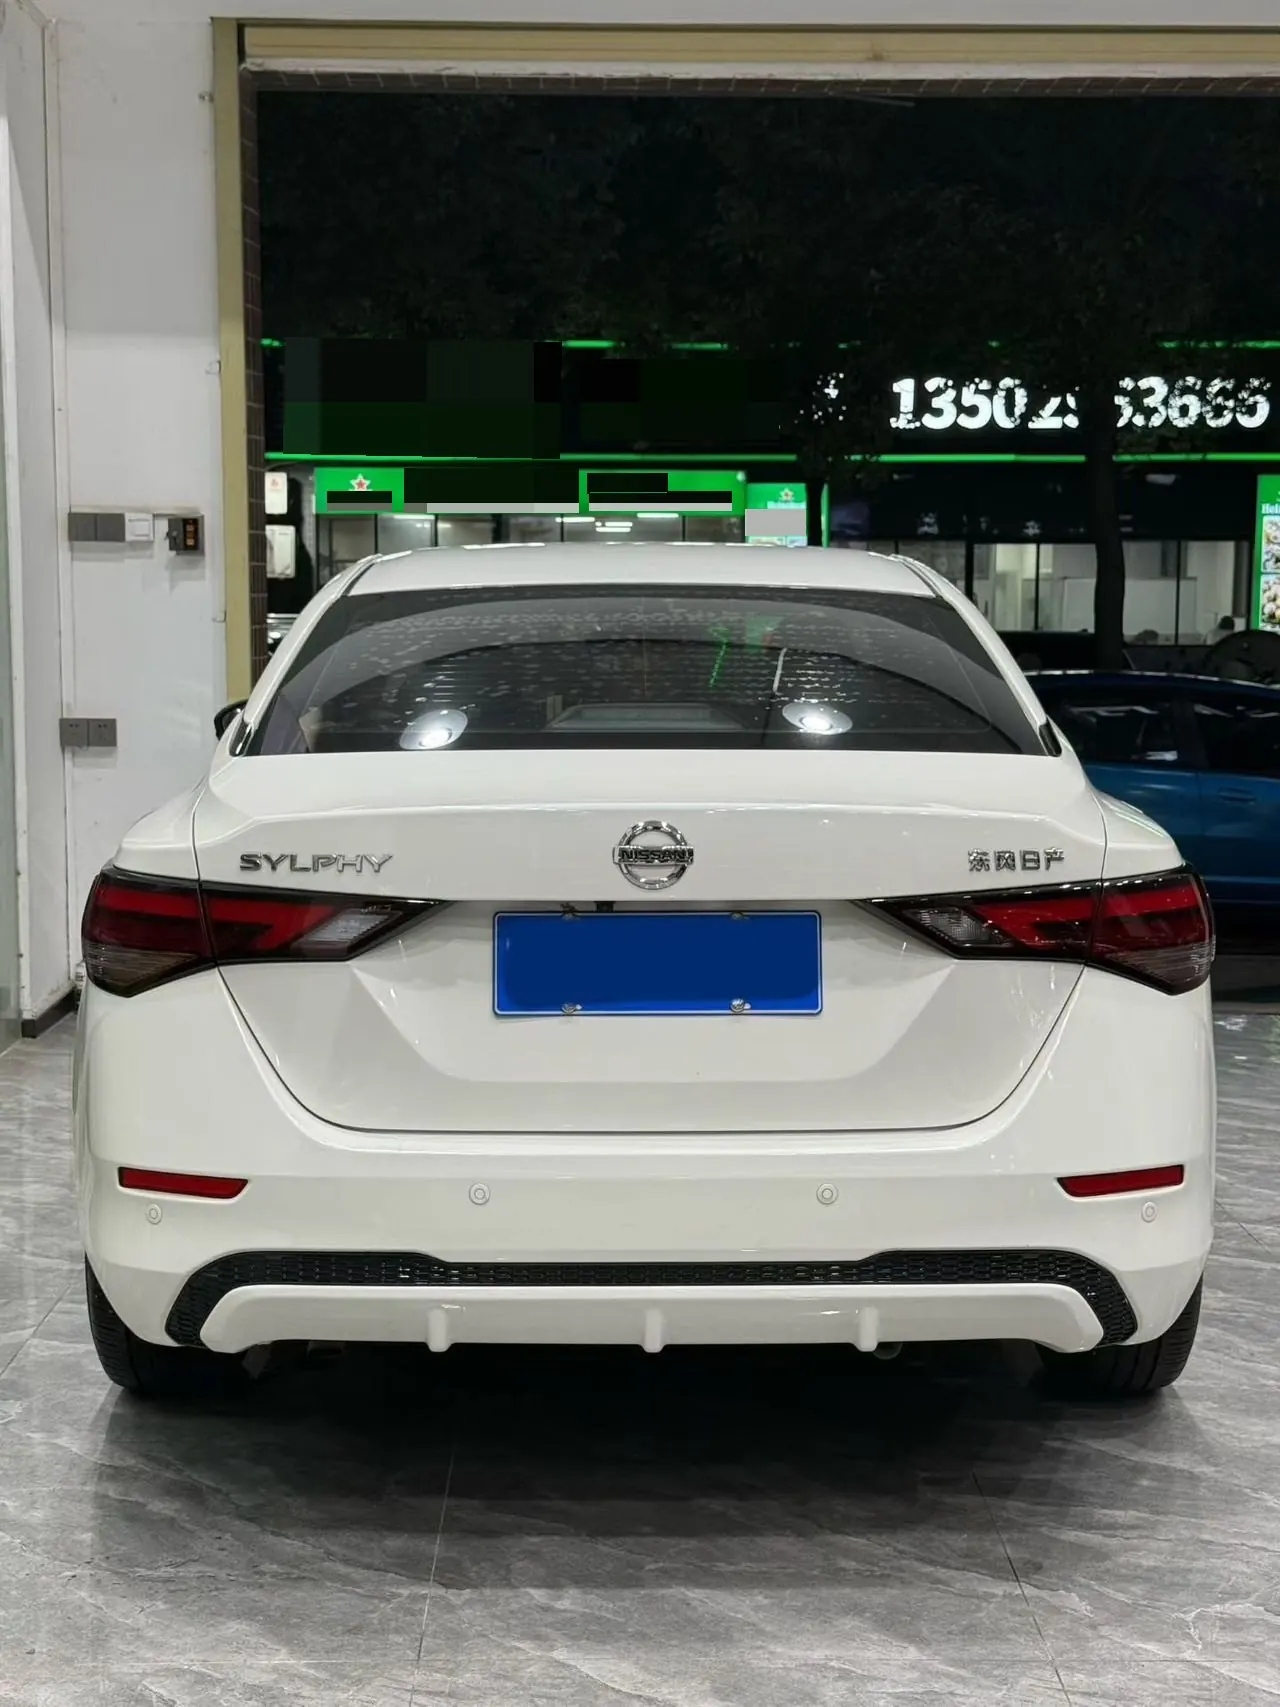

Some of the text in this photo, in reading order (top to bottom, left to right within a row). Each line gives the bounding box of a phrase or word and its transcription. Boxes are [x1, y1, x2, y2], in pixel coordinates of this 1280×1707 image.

[239, 853, 392, 874] SYLPHY
[621, 849, 686, 861] NISSAN
[968, 847, 1065, 873] 东风日产
